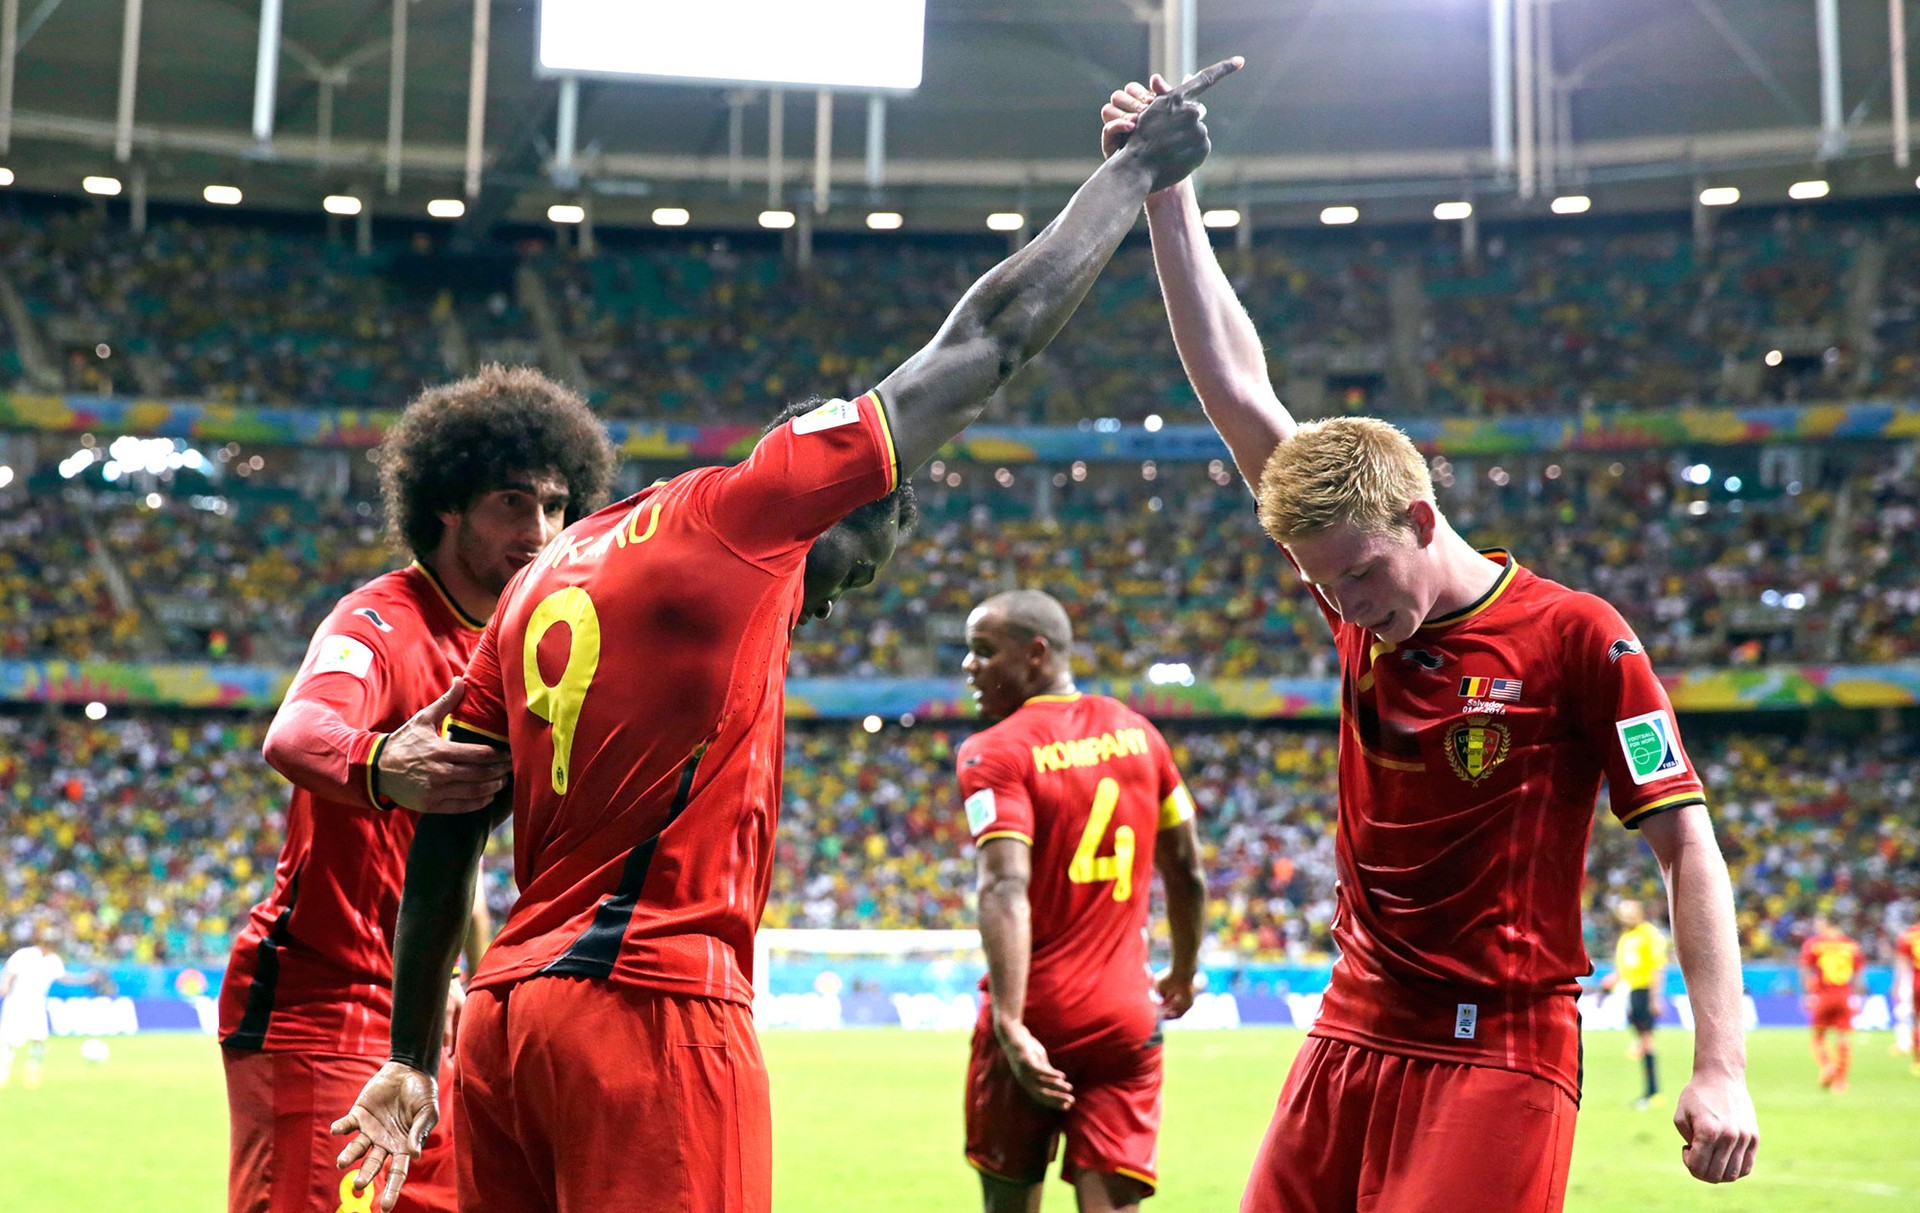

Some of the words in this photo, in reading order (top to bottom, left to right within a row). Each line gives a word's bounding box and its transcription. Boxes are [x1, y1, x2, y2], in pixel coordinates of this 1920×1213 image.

[523, 586, 601, 795] 9
[1467, 699, 1504, 708] Salvador
[1032, 728, 1149, 773] KOMPANY
[1628, 732, 1655, 742] FOOTBALL
[1641, 737, 1655, 745] HOPE
[1068, 777, 1135, 902] 4
